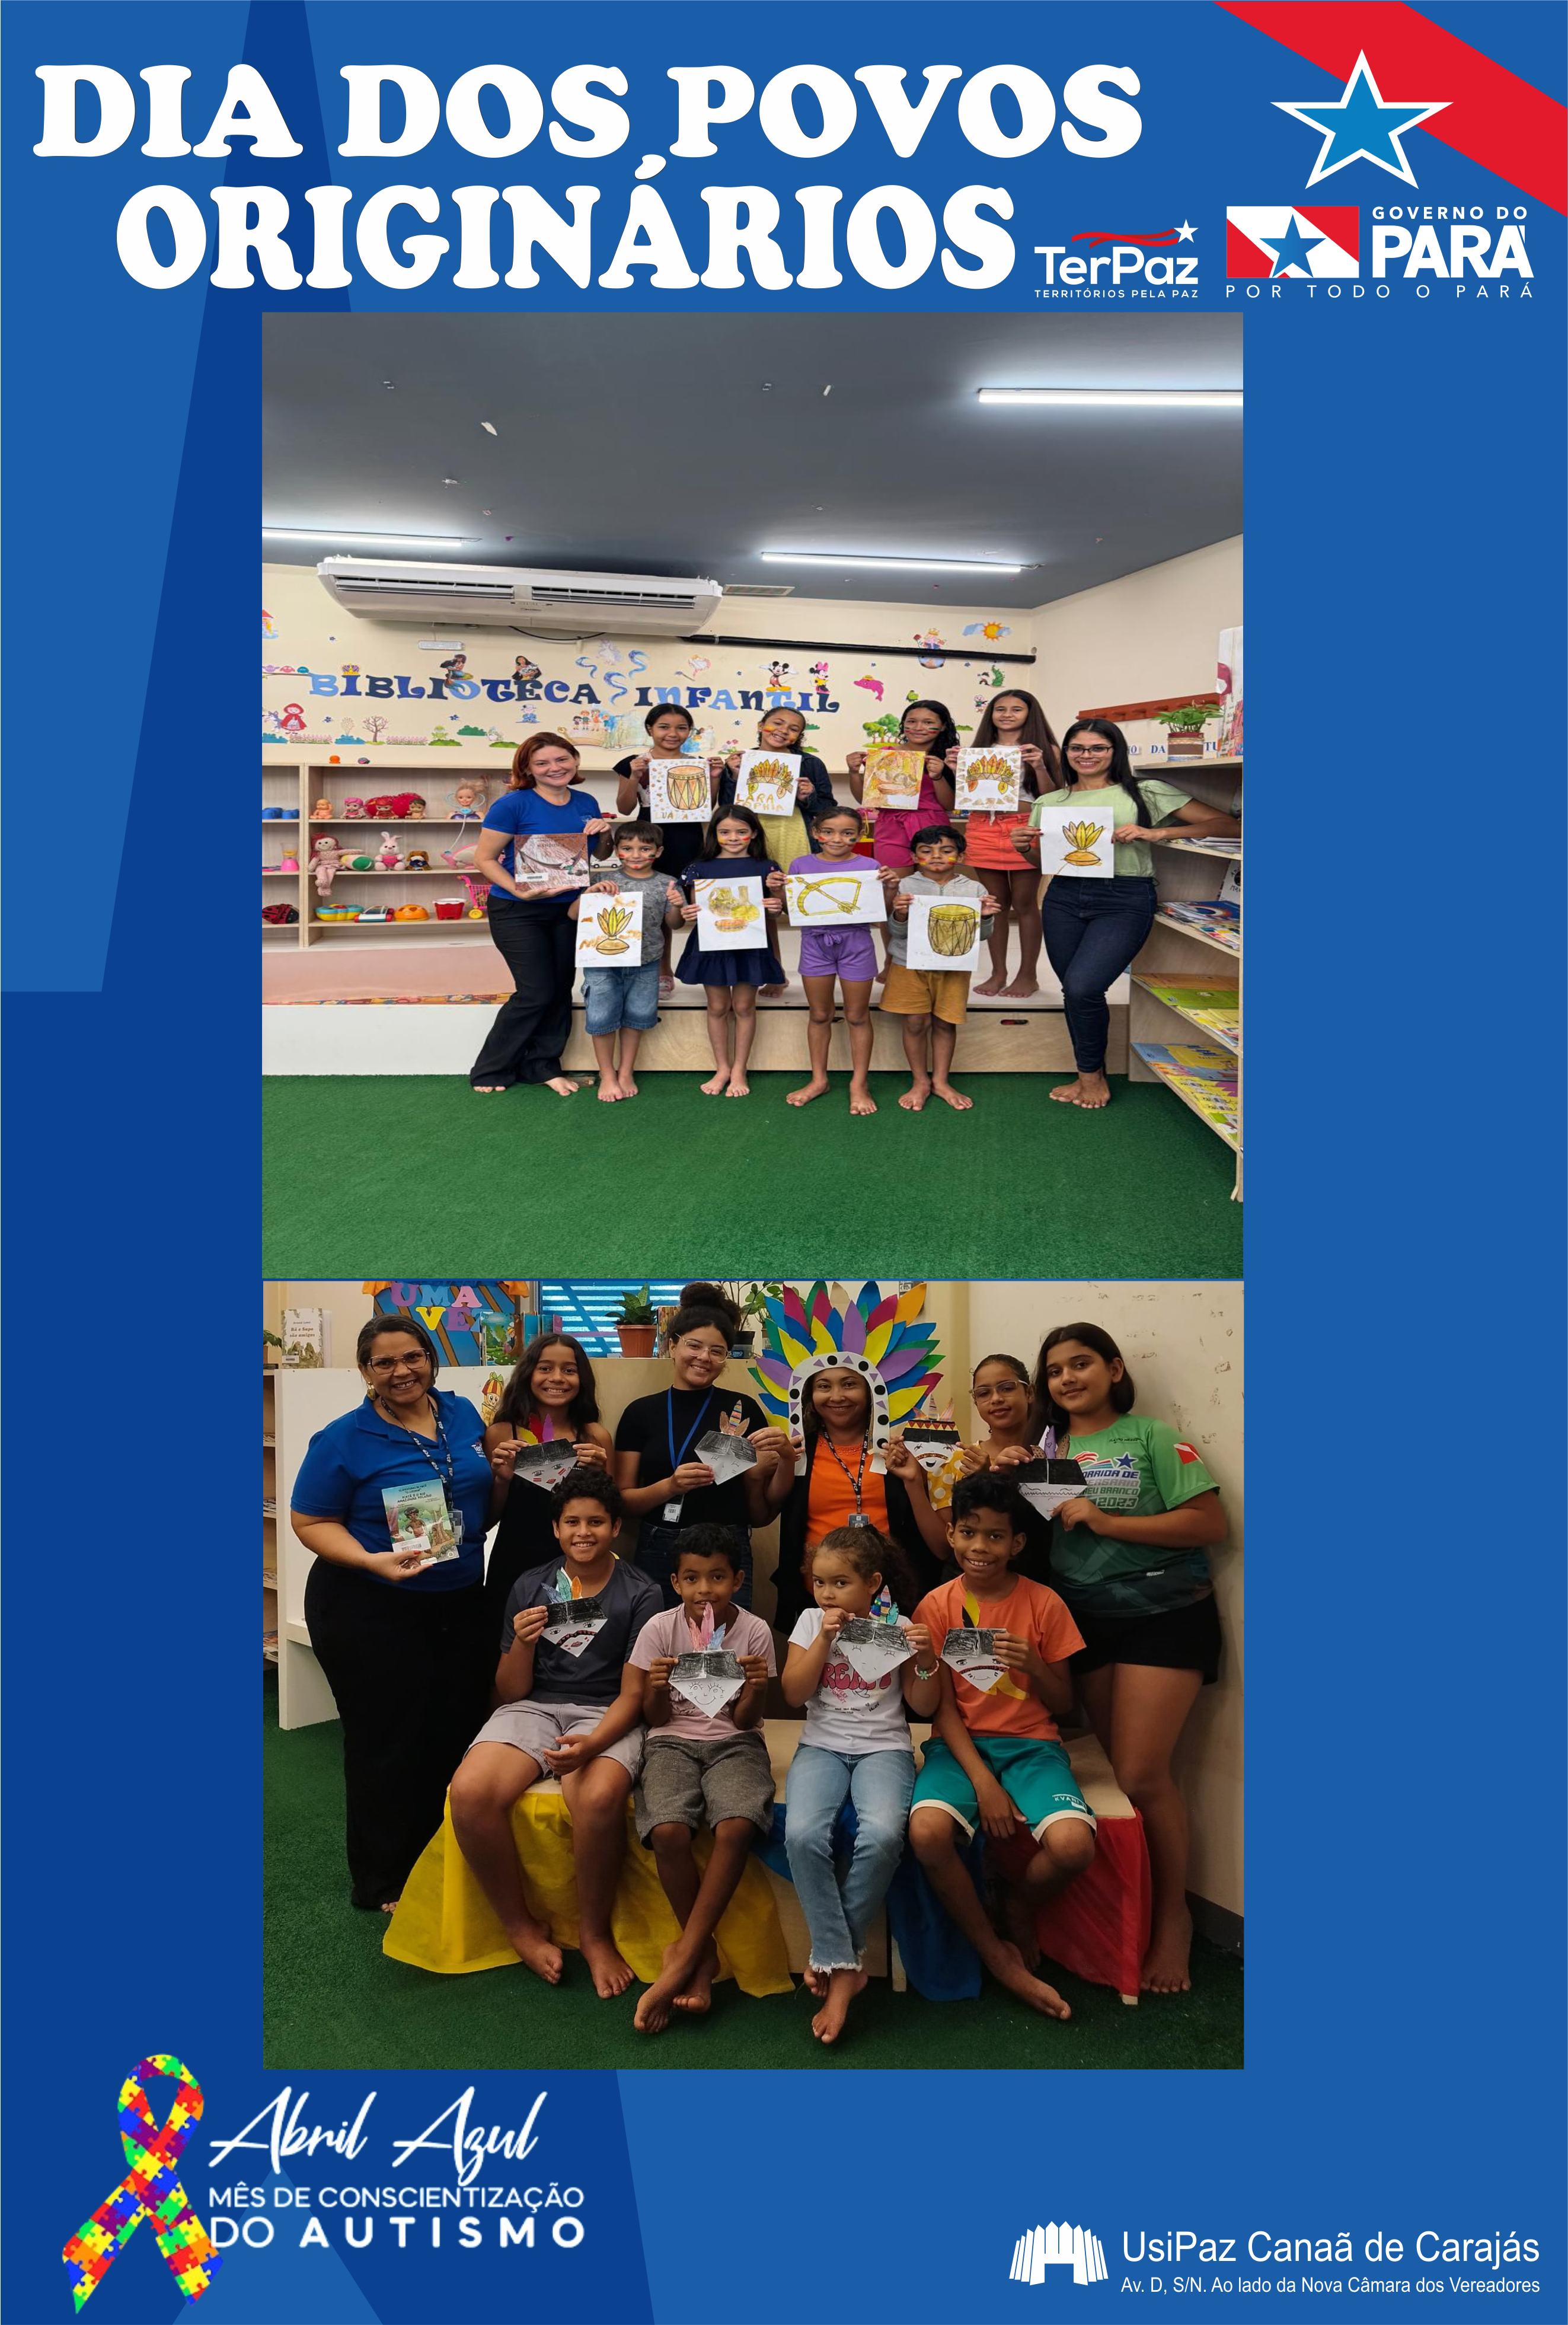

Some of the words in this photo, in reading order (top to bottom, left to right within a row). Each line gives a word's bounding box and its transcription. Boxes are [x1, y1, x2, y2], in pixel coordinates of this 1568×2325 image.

[308, 672, 601, 704] BIBLIOTECA
[1151, 745, 1165, 754] DA
[390, 1283, 483, 1308] UMA
[1083, 1469, 1120, 1478] ORRIDA
[1122, 1471, 1139, 1479] DE
[1087, 1479, 1139, 1487] ERSARIO
[1100, 1487, 1139, 1495] BRANCO
[1097, 1497, 1138, 1507] 2023
